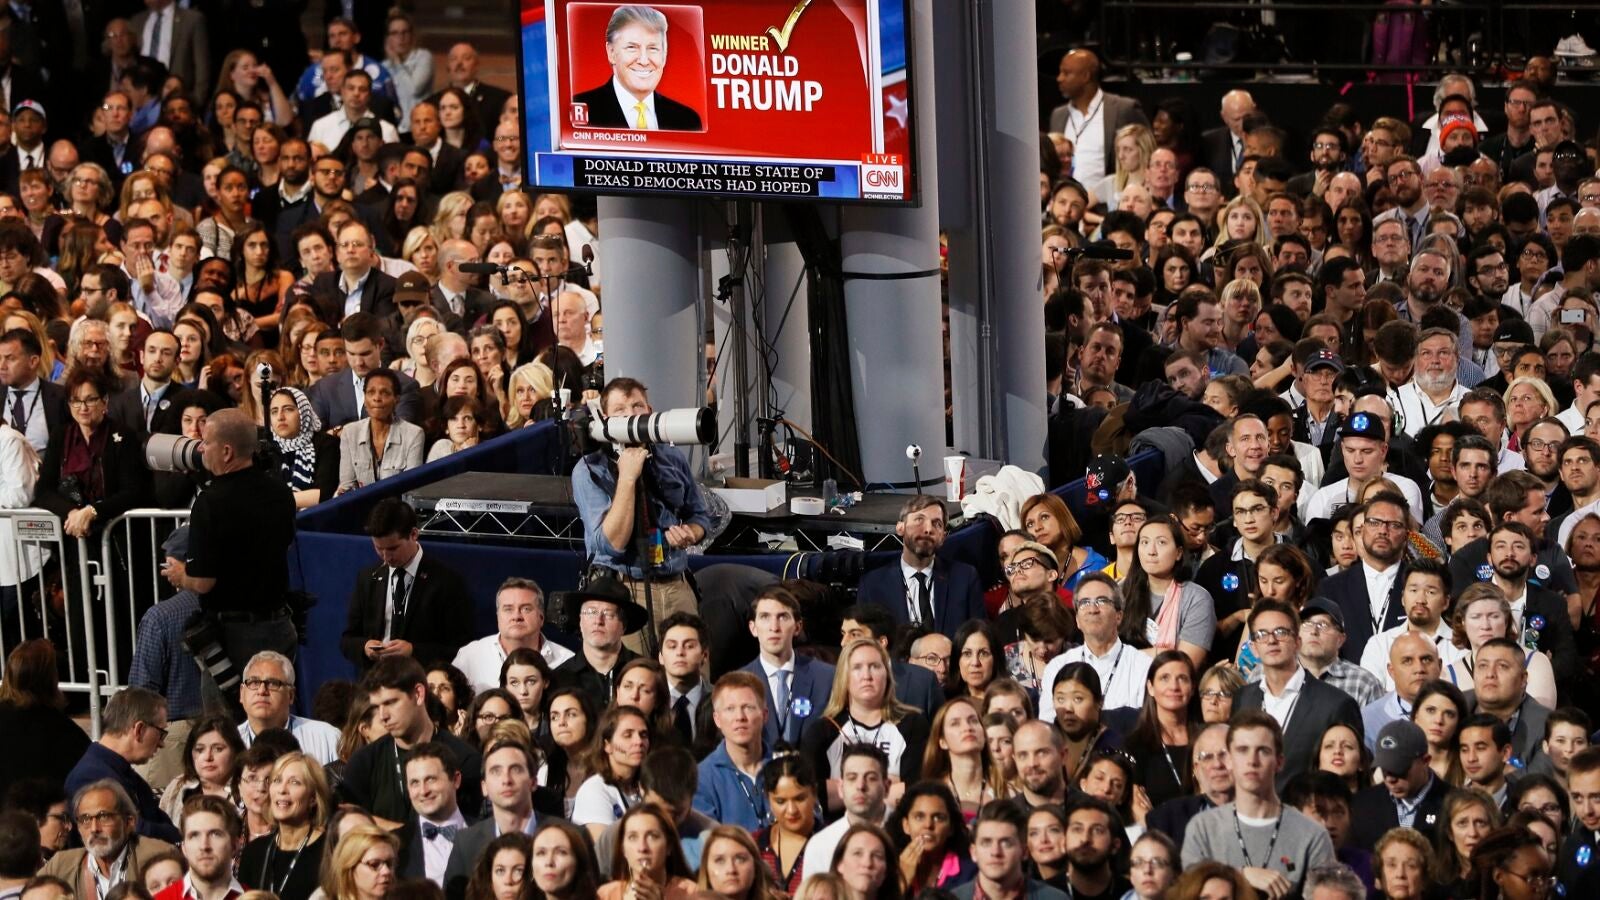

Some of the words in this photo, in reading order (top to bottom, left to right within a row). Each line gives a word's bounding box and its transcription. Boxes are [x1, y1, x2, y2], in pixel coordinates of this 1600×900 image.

[711, 35, 769, 51] WINNER
[712, 54, 798, 76] DONALD
[711, 78, 822, 112] TRUMP
[575, 106, 583, 121] R
[573, 131, 592, 141] CNN
[594, 132, 647, 143] PROJECTION
[866, 154, 898, 165] LIVE
[584, 159, 644, 173] DONALD
[647, 161, 699, 175] TRUMP
[701, 163, 718, 176] IN
[721, 164, 752, 177] THE
[756, 165, 800, 179] STATE
[804, 167, 824, 179] OF
[584, 174, 630, 187] TEXAS
[634, 176, 722, 190] DEMOCRATS
[727, 180, 757, 192] HAD
[761, 181, 811, 194] HOPED
[867, 171, 898, 188] CNN
